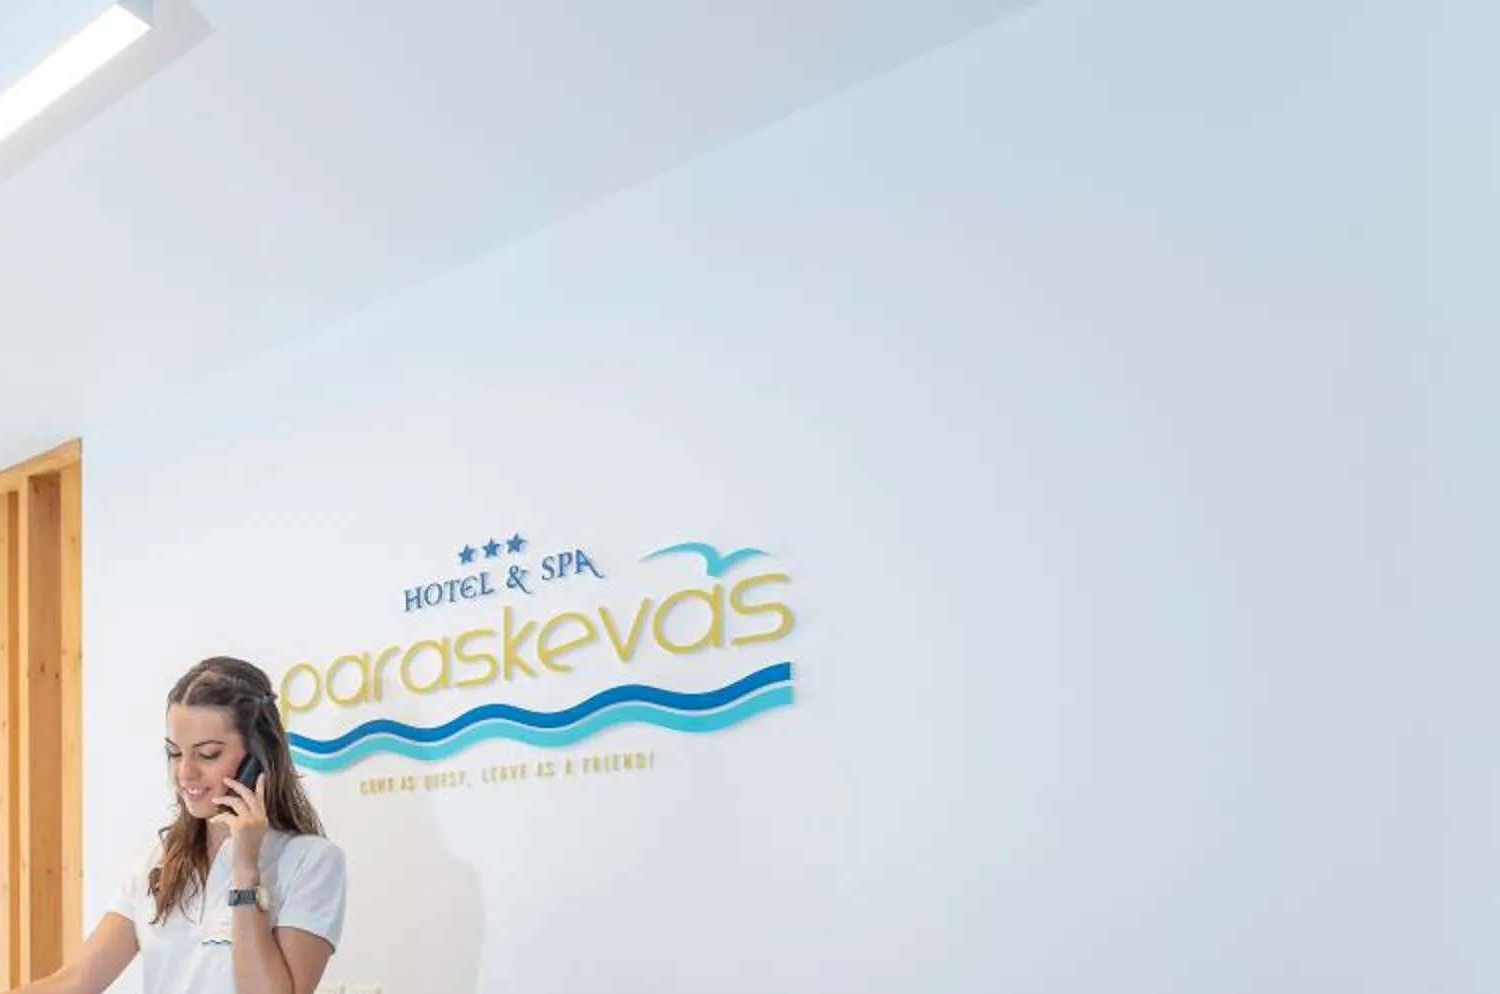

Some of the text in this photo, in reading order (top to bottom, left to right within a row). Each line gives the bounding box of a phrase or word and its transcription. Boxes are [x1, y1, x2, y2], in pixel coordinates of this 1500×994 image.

[404, 549, 604, 612] HOTEL & SPA
[278, 573, 794, 732] paraskevas
[481, 764, 527, 784] LEAVE
[537, 760, 556, 777] AS
[565, 756, 574, 775] A
